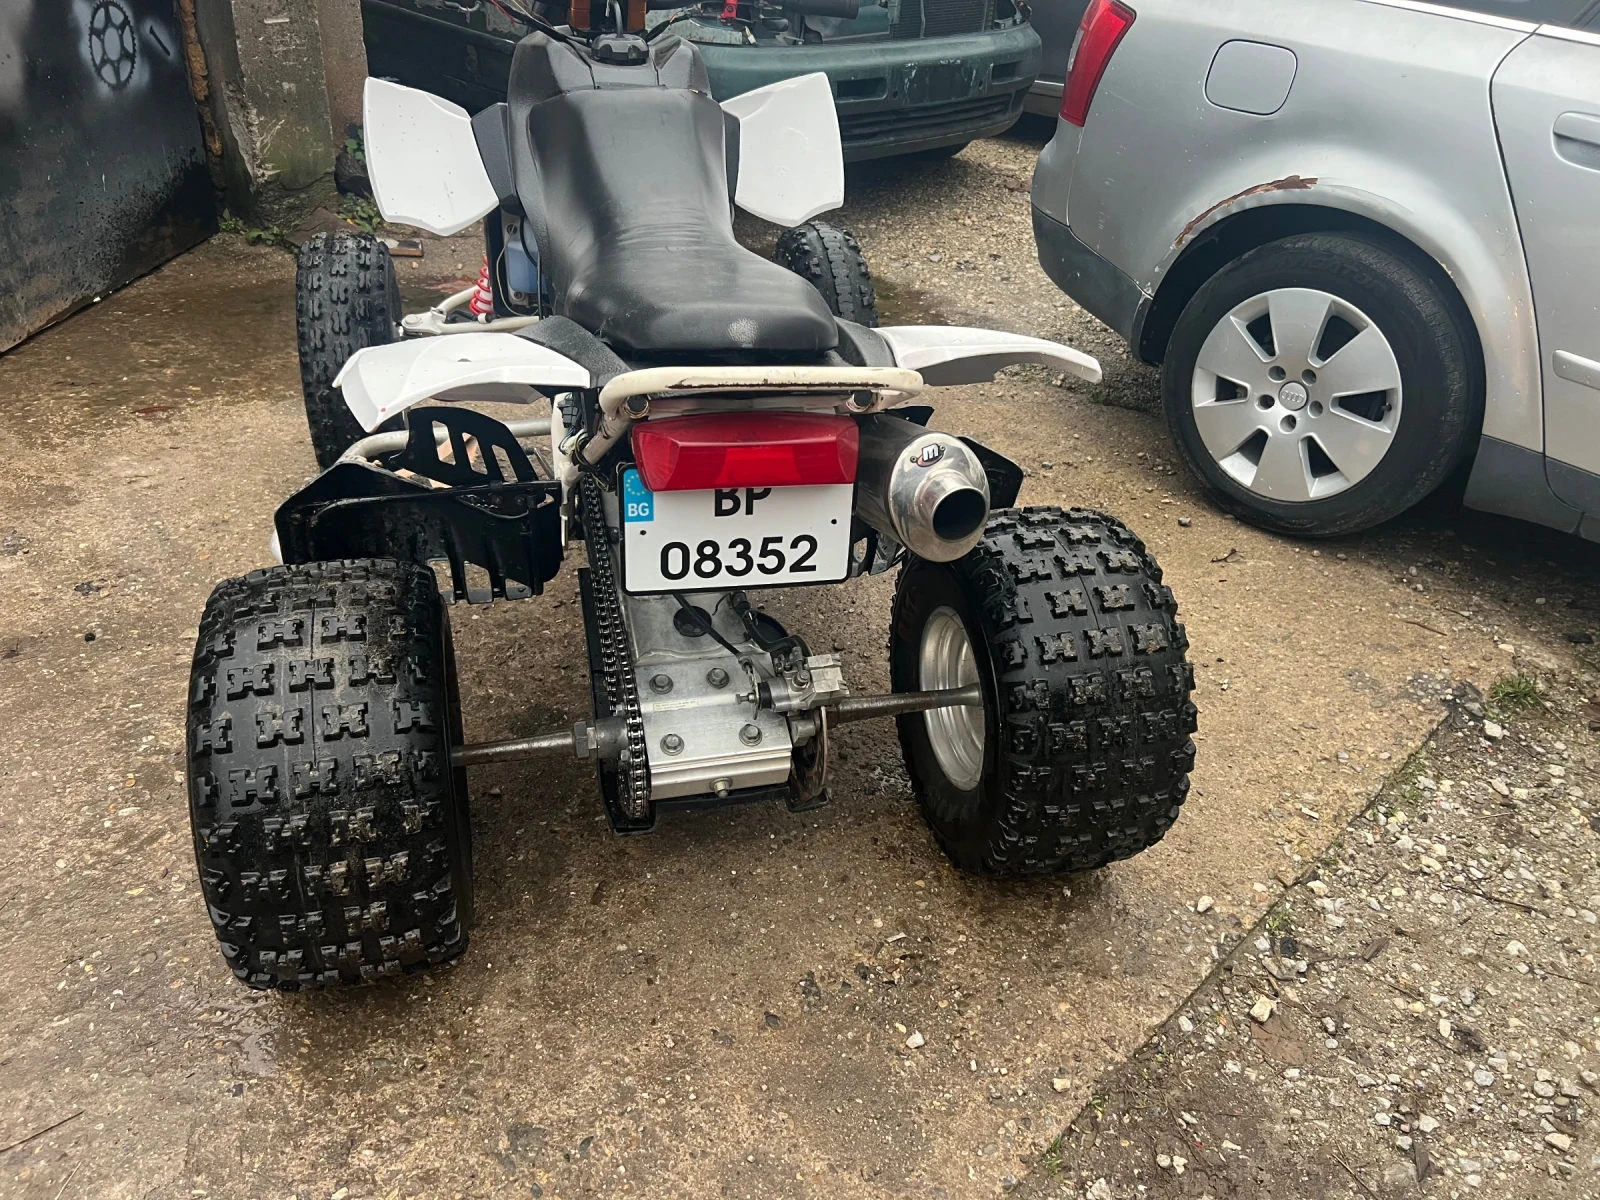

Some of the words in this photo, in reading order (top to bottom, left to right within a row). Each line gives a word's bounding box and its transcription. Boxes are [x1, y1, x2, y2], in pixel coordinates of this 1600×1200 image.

[627, 503, 650, 517] BG
[714, 487, 772, 517] BP
[660, 534, 818, 580] 08352
